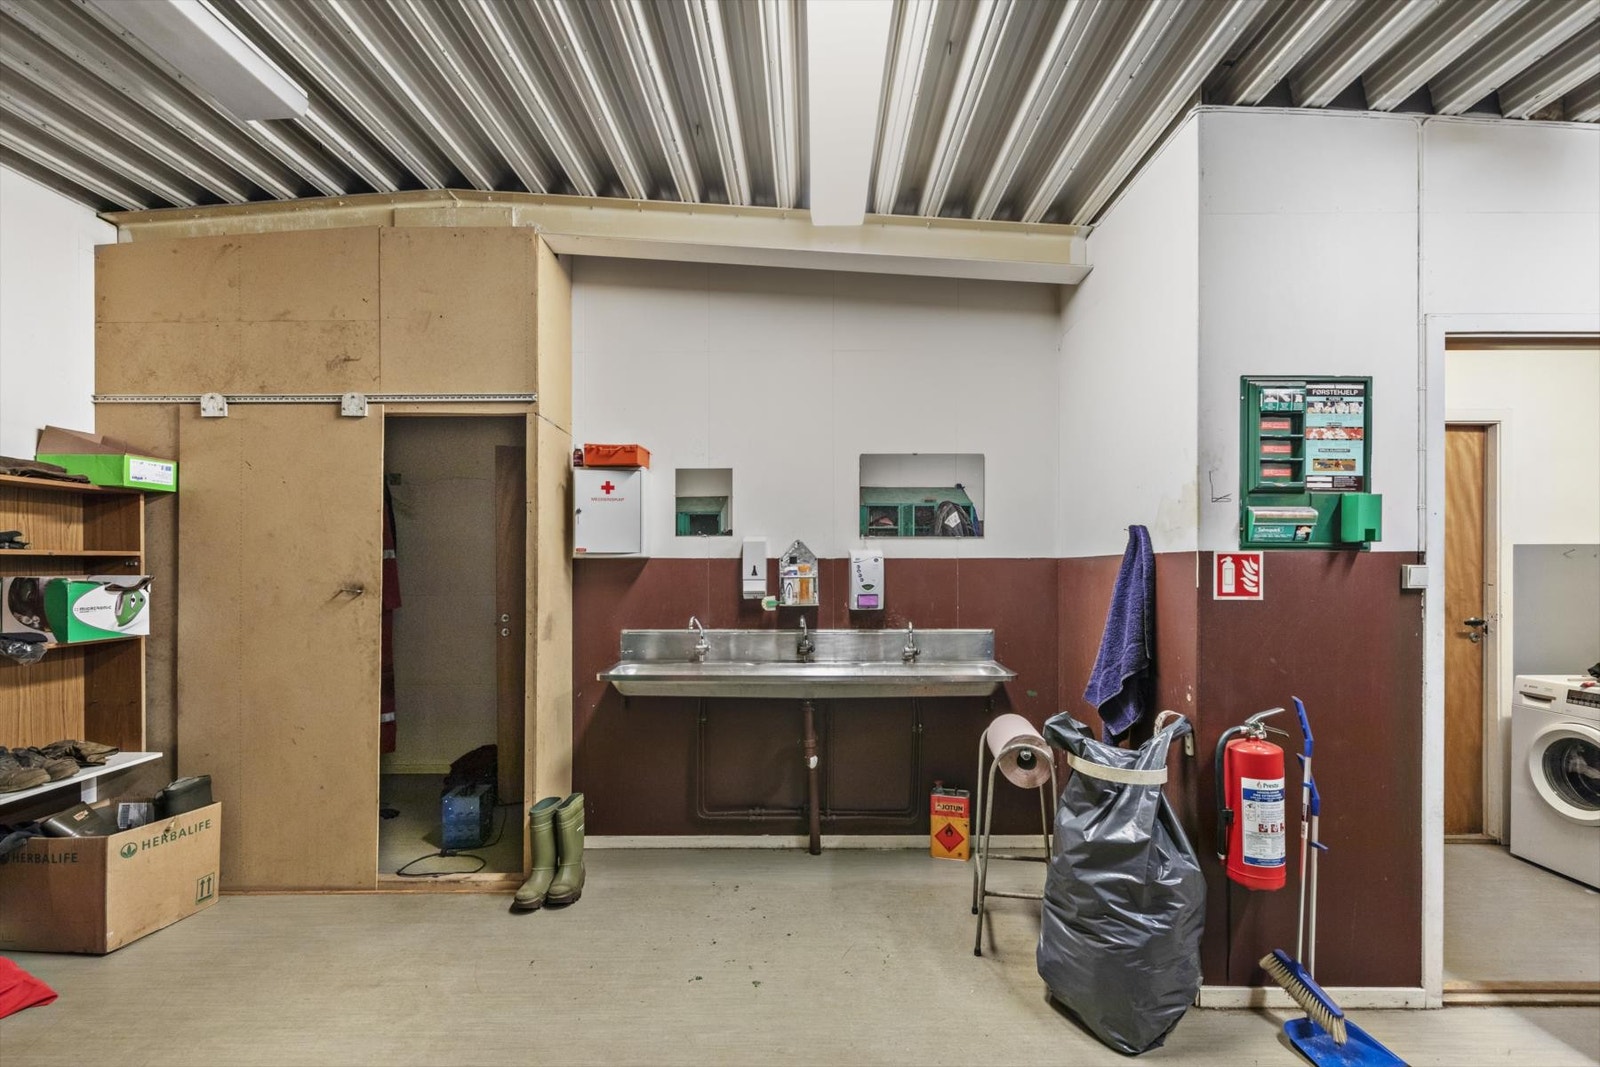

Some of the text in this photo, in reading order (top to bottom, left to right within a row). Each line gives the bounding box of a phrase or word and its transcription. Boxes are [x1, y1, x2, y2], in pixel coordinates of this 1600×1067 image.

[941, 804, 963, 812] JOTUN
[141, 818, 212, 851] HERBALIFE
[12, 852, 79, 865] HERBALIFE
